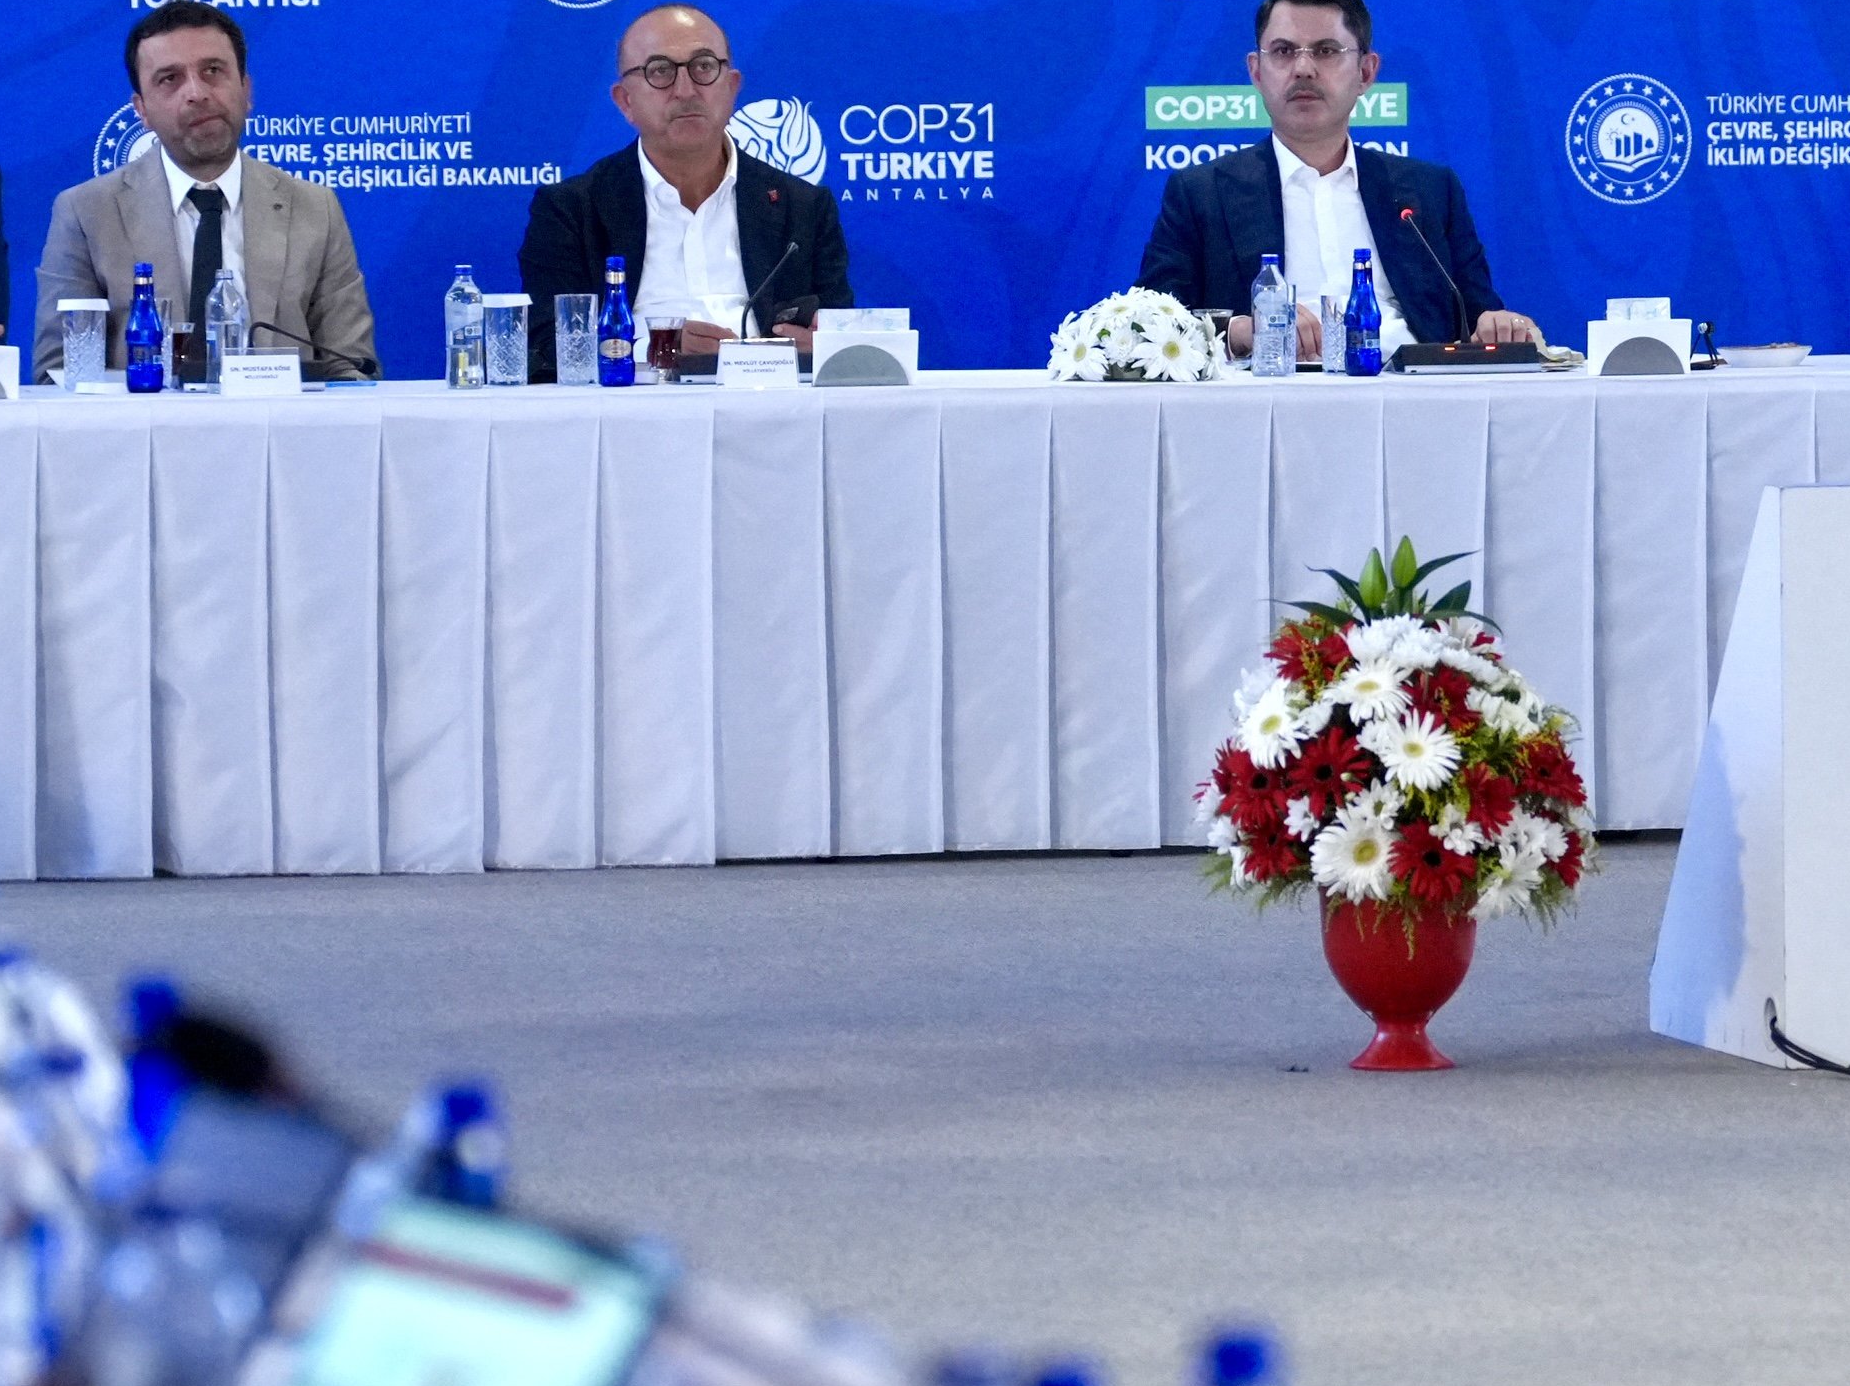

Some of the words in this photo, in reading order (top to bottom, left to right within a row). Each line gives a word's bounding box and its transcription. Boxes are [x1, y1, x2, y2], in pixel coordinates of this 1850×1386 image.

[1154, 94, 1257, 122] COP31
[1706, 92, 1786, 115] TÜRKİYE
[245, 114, 326, 137] TÜRKİYE
[330, 111, 471, 136] CUMHURİYETİ
[839, 102, 994, 145] COP31
[1706, 121, 1779, 145] ÇEVRE,
[322, 137, 441, 167] ŞEHİRCİLİK
[443, 141, 473, 160] VE
[840, 150, 994, 181] TÜRKİYE
[1707, 142, 1765, 166] İKLİM
[308, 164, 437, 192] DEĞİŞİKLİĞİ
[442, 162, 562, 186] BAKANLIĞI
[841, 186, 994, 201] ANTALYA
